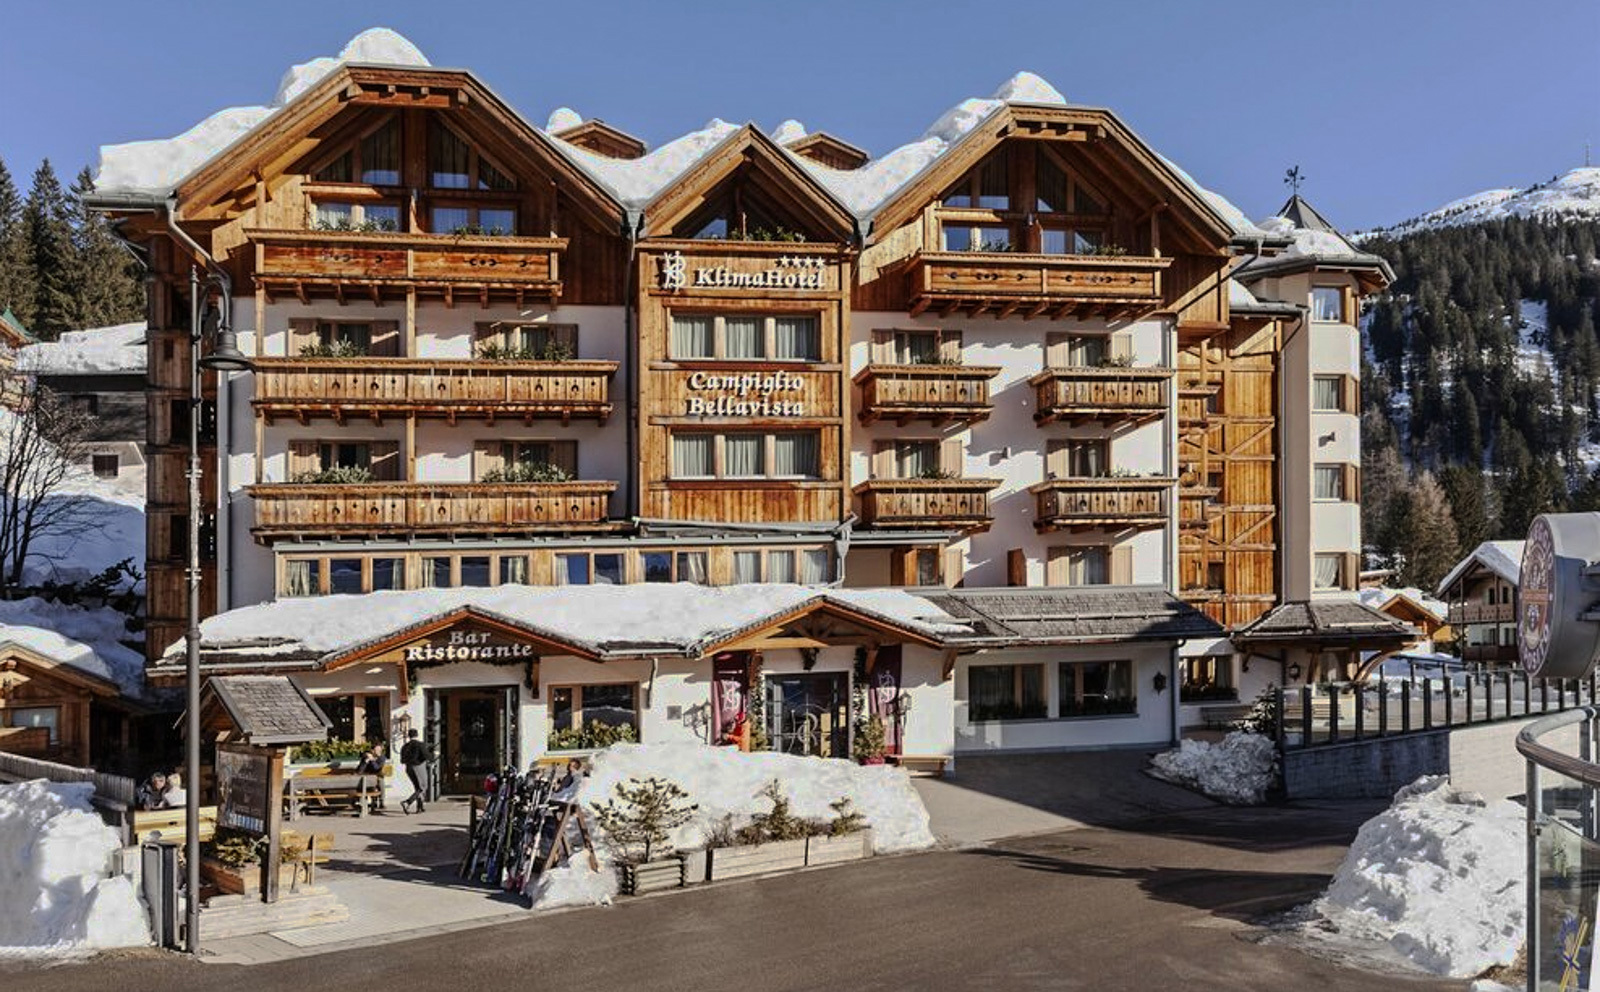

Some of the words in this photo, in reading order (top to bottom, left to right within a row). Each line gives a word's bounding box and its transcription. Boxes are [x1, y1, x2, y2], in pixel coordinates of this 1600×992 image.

[696, 267, 826, 287] KlimaHotel
[690, 371, 805, 396] Campiglio
[688, 397, 804, 416] Bellavista
[448, 630, 492, 645] Bar
[405, 643, 534, 660] Ristorante
